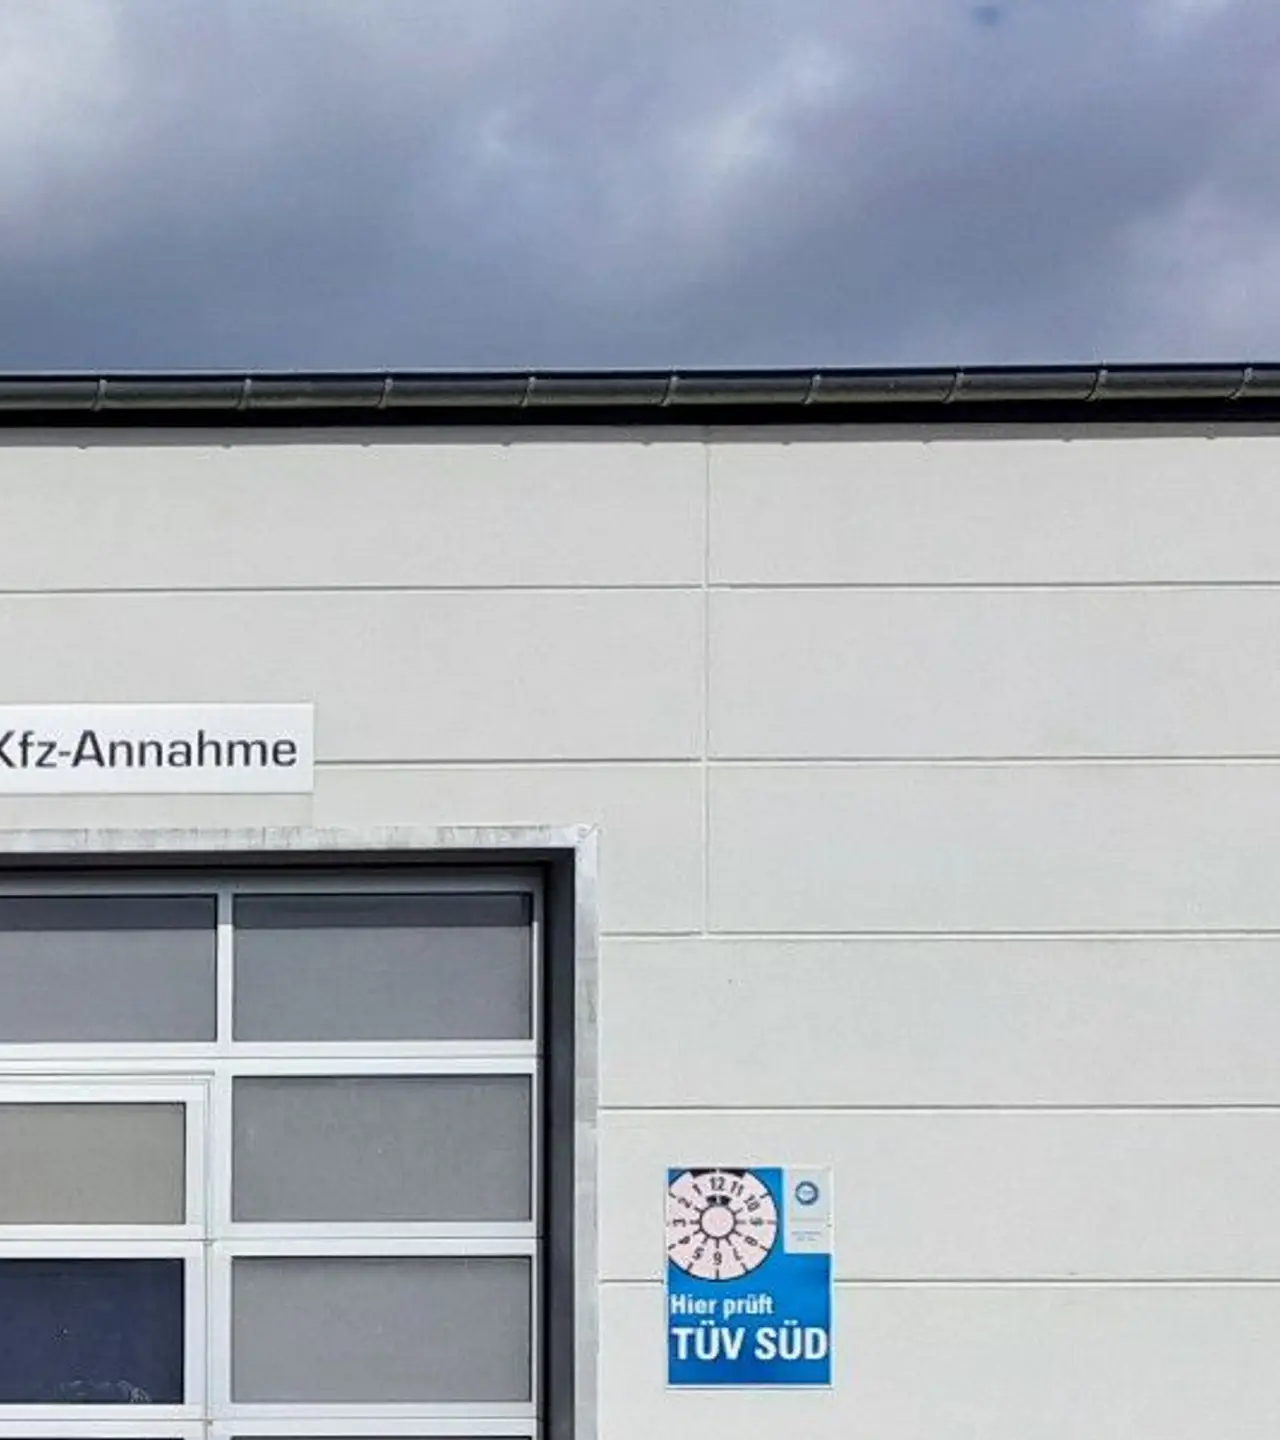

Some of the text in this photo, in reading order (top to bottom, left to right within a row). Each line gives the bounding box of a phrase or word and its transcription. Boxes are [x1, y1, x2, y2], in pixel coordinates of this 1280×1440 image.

[709, 1176, 726, 1191] 12
[730, 1180, 745, 1197] 11
[743, 1194, 761, 1212] 10
[670, 1293, 775, 1320] Hier prüft
[670, 1319, 829, 1361] TÜV SÜD
